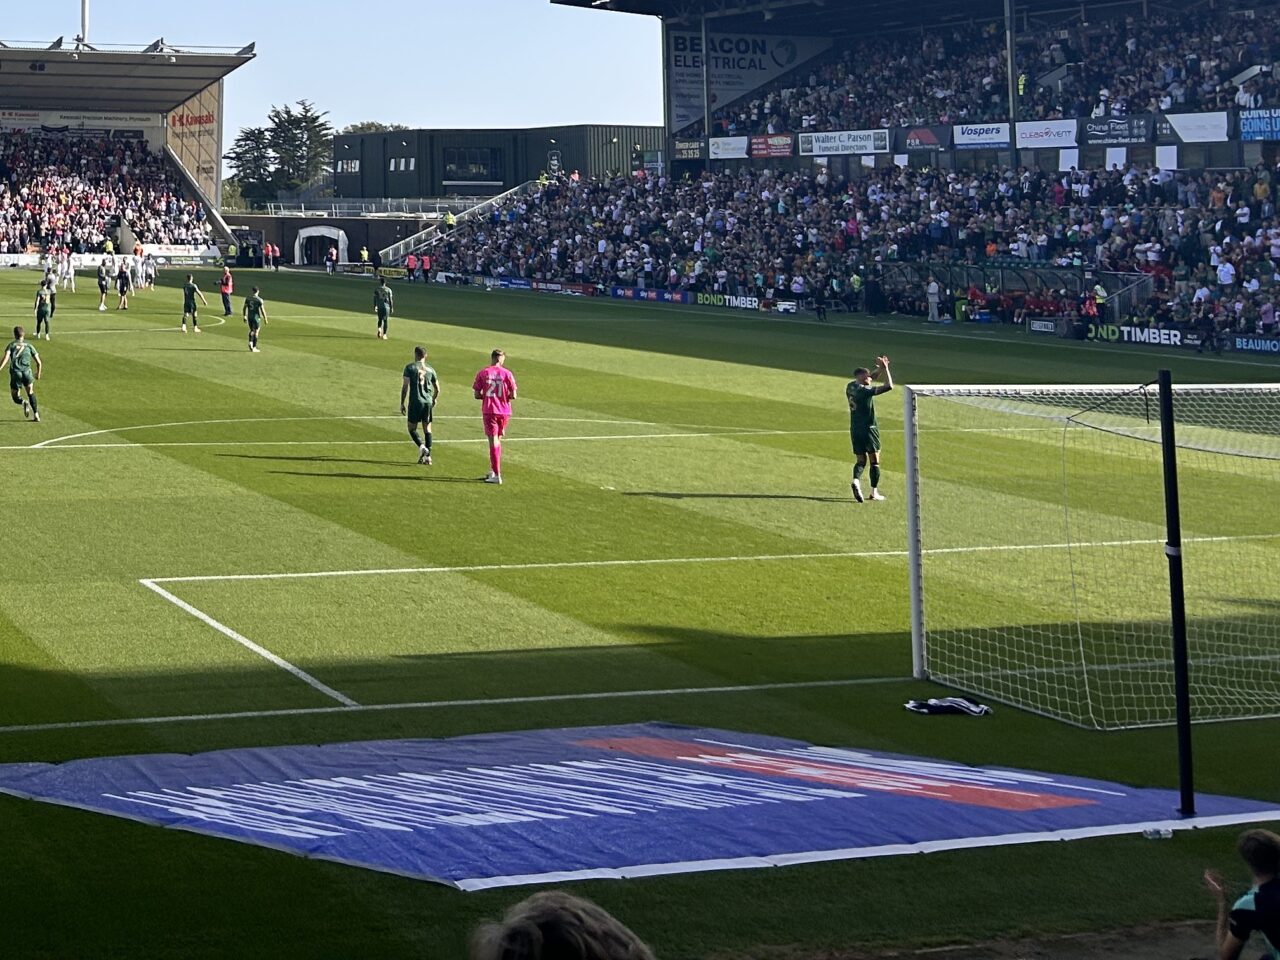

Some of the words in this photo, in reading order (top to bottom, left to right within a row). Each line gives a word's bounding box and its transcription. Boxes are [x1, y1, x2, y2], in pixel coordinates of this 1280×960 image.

[673, 36, 767, 55] BEACON
[674, 55, 767, 70] ELETRICAL
[186, 111, 215, 126] Kawasaki
[1241, 118, 1271, 132] GOING
[961, 125, 1001, 137] Vospers
[1087, 123, 1108, 131] China
[1110, 122, 1129, 131] Fleet
[814, 134, 837, 144] Walter
[847, 133, 871, 142] Parson
[818, 144, 840, 153] Funeral
[841, 144, 868, 152] Directors
[697, 293, 724, 306] BOND
[724, 295, 759, 308] TIMBER
[1087, 324, 1119, 340] OND
[1120, 326, 1181, 346] TIMBER
[1235, 338, 1280, 352] BEAUMO
[485, 378, 504, 397] 21
